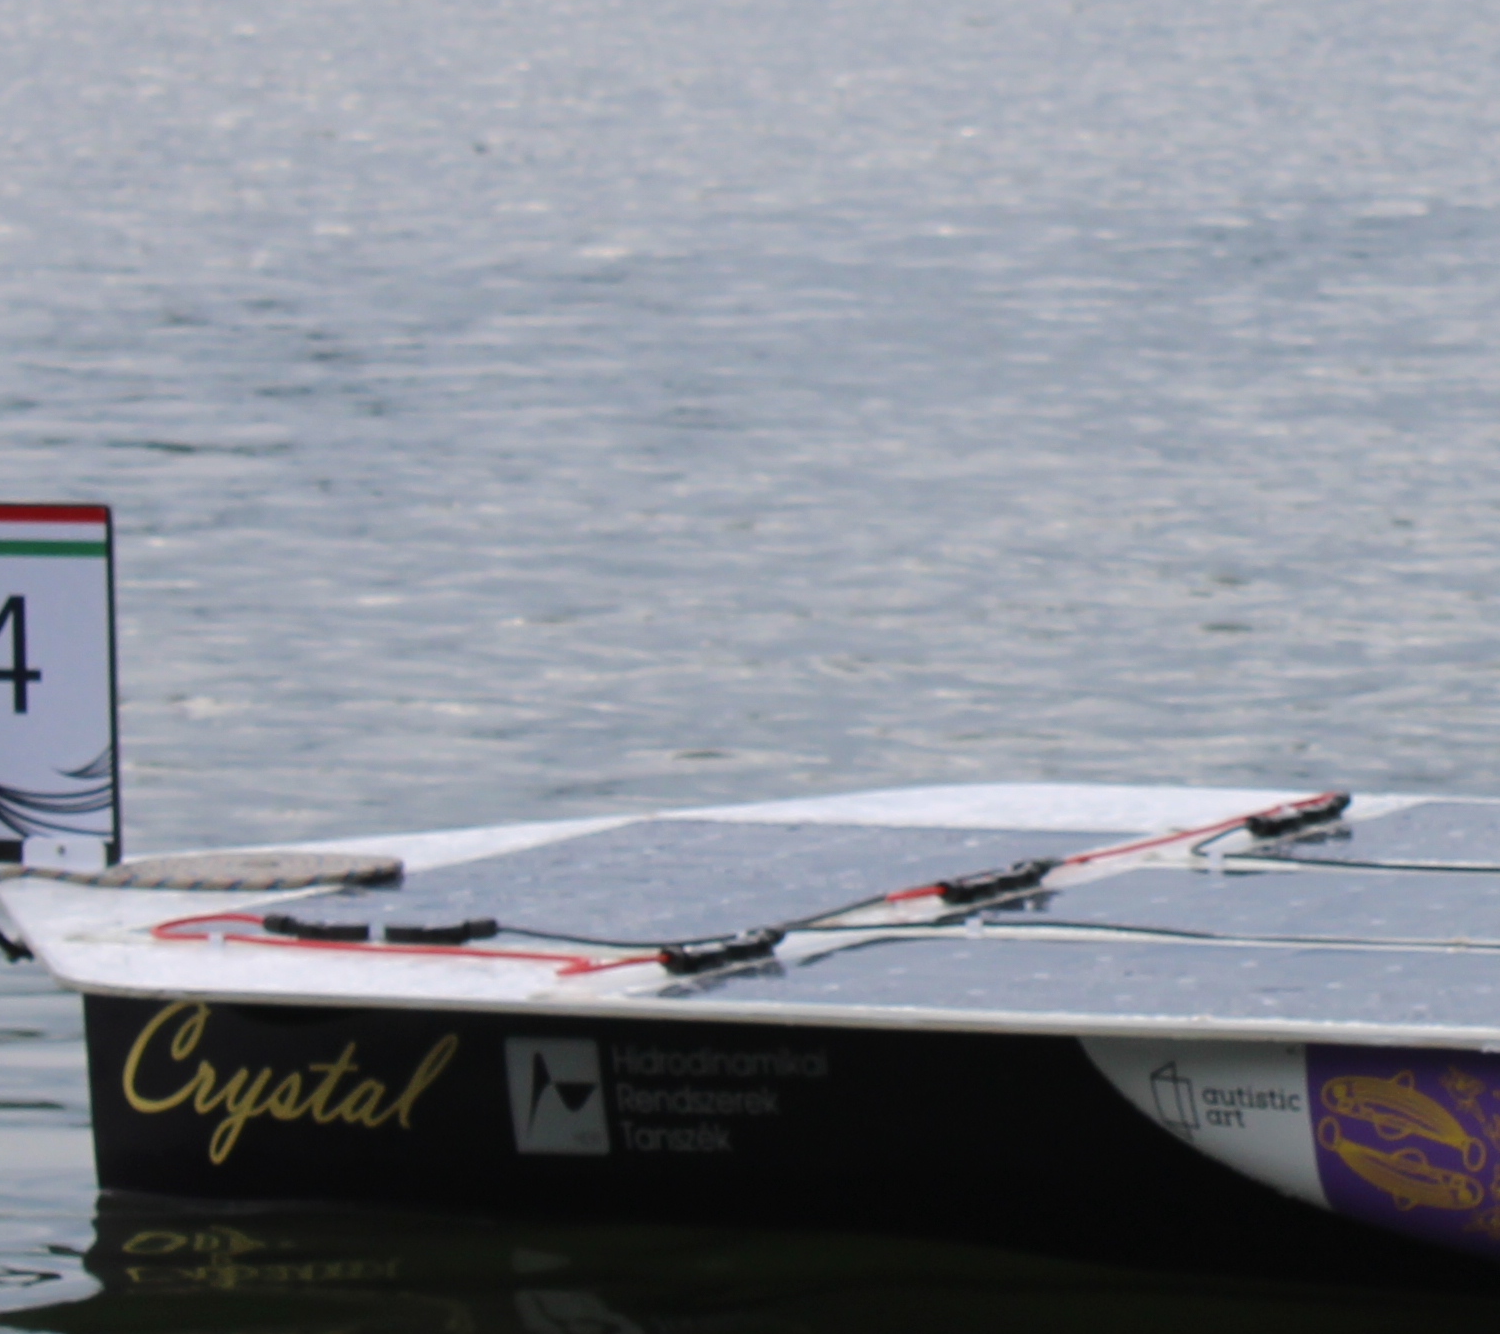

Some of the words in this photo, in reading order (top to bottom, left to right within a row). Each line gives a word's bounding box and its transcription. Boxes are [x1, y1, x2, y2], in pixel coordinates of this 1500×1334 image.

[612, 1045, 829, 1078] Hidrodinamikai
[122, 1001, 460, 1165] Crystal
[615, 1083, 780, 1116] Rendszerek
[1203, 1086, 1300, 1111] autistic
[1206, 1109, 1245, 1128] art
[621, 1119, 734, 1153] Tanszék
